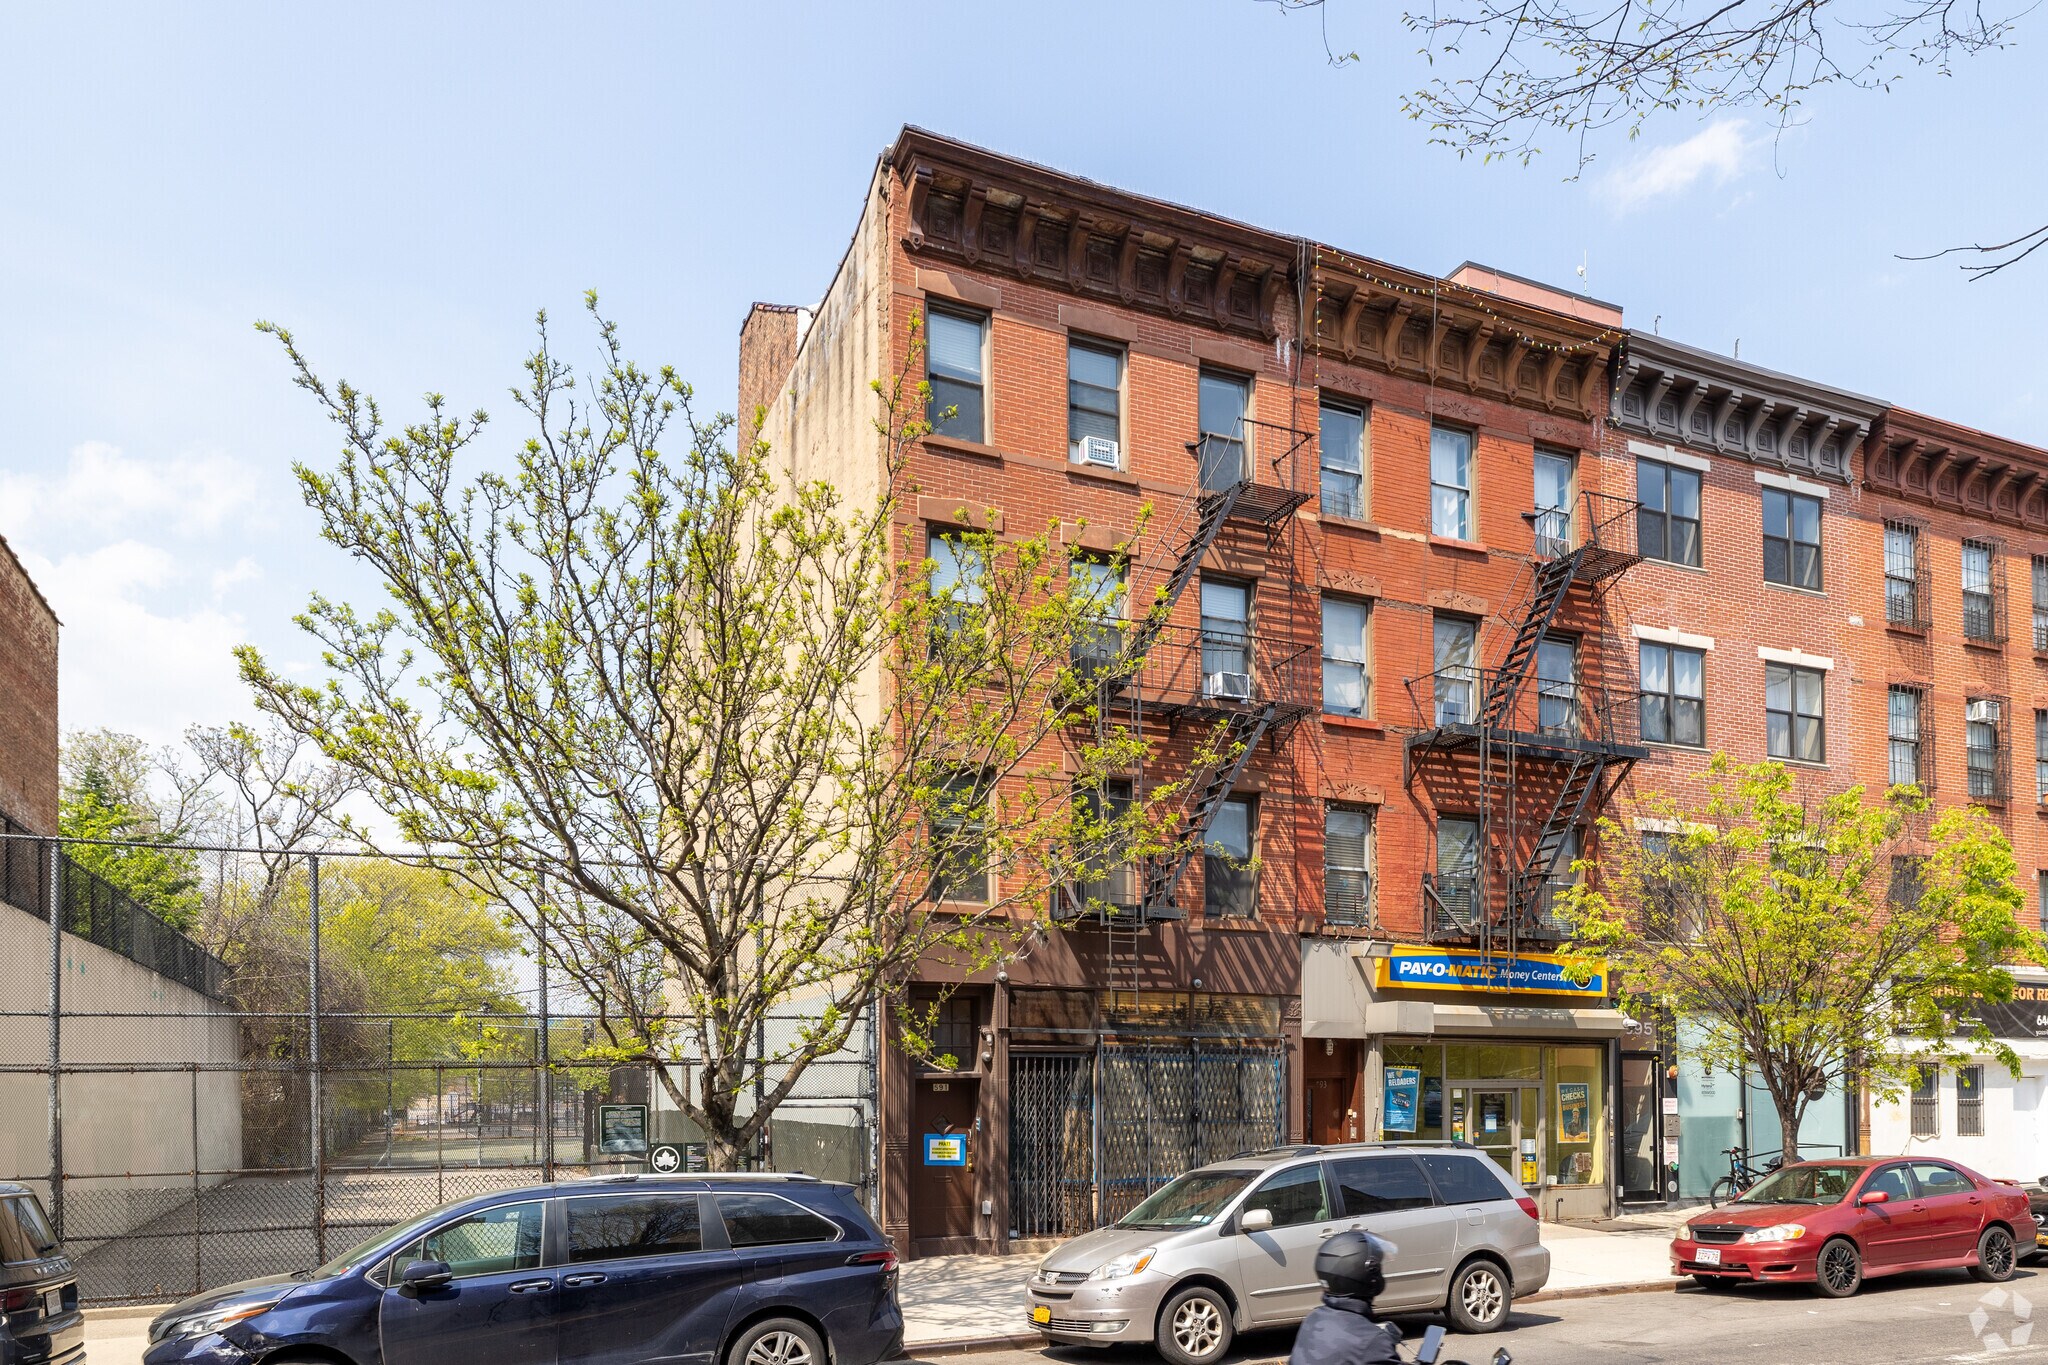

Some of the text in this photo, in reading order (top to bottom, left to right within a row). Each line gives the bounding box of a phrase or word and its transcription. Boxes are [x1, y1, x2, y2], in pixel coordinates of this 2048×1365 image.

[1500, 968, 1530, 981] Money
[1531, 970, 1564, 983] Centers
[2013, 986, 2035, 1000] FOR
[2036, 1015, 2048, 1026] 64
[1561, 1091, 1585, 1101] CHECKS
[1563, 1102, 1587, 1111] BUSINESS
